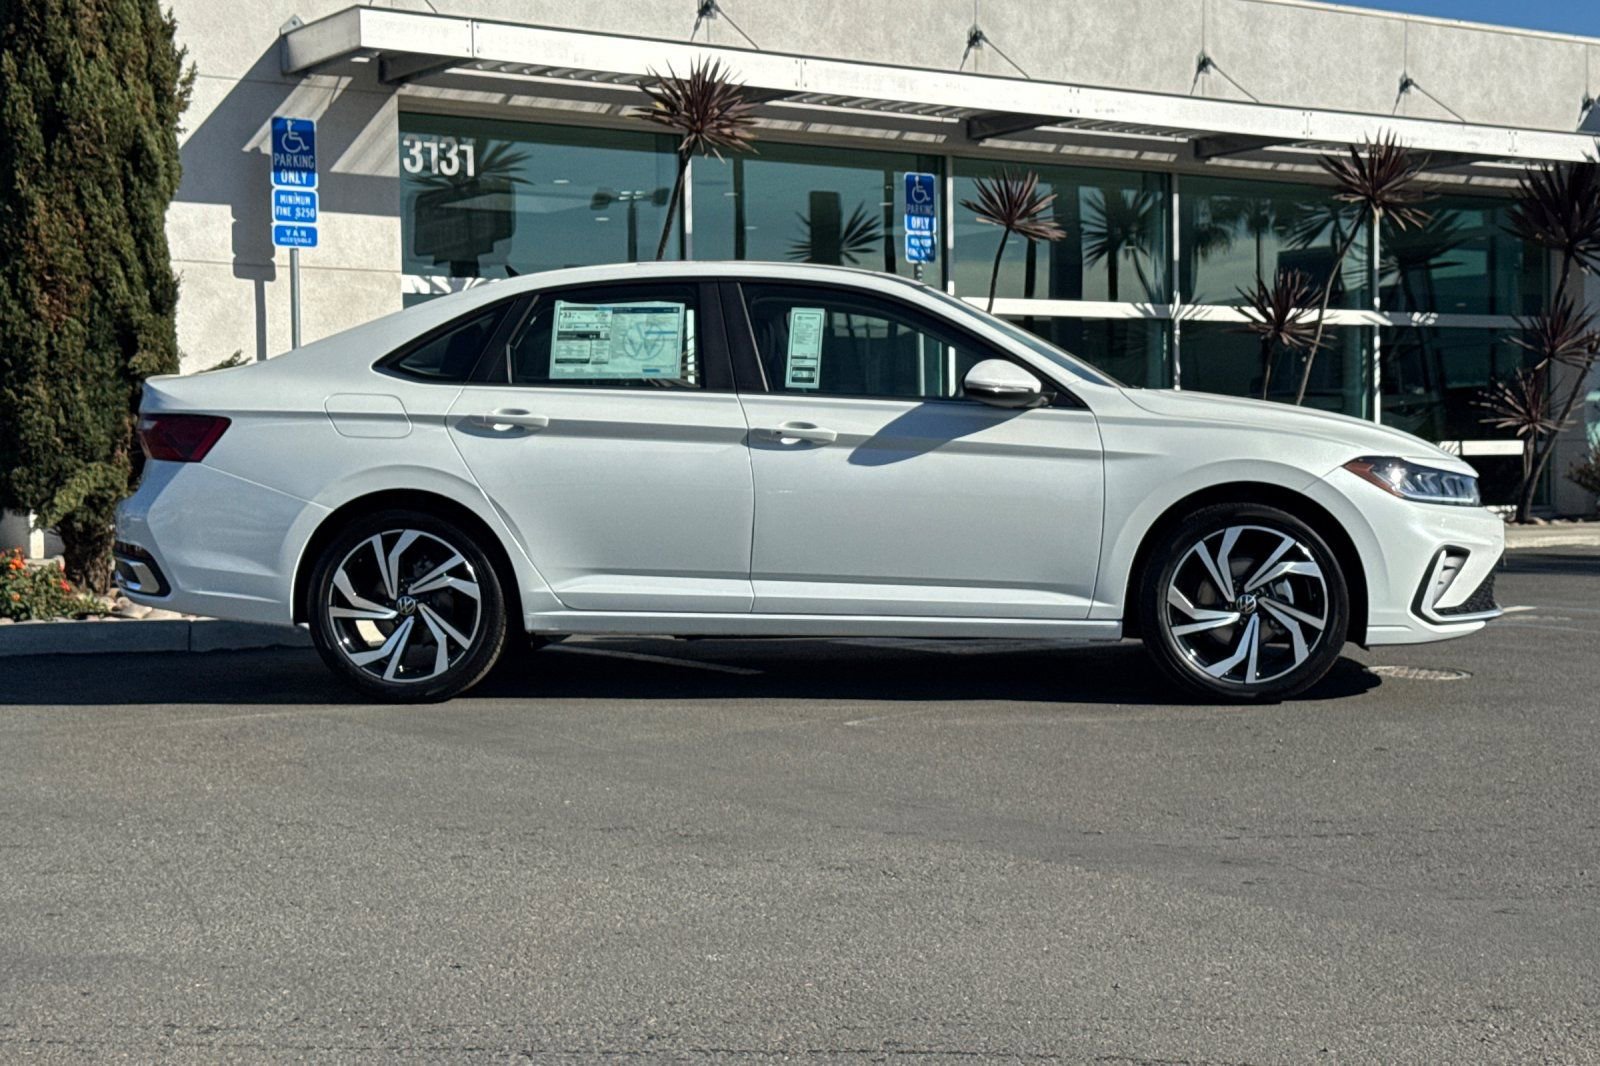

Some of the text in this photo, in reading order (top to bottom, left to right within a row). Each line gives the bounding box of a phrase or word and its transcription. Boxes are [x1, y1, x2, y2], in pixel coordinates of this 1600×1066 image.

[273, 153, 315, 169] PARKING
[402, 134, 475, 177] 3131
[280, 170, 308, 185] ONLY
[279, 194, 311, 206] MINIMUM
[276, 205, 315, 219] FINE $250
[911, 215, 930, 230] ONLY
[285, 228, 307, 238] VAN
